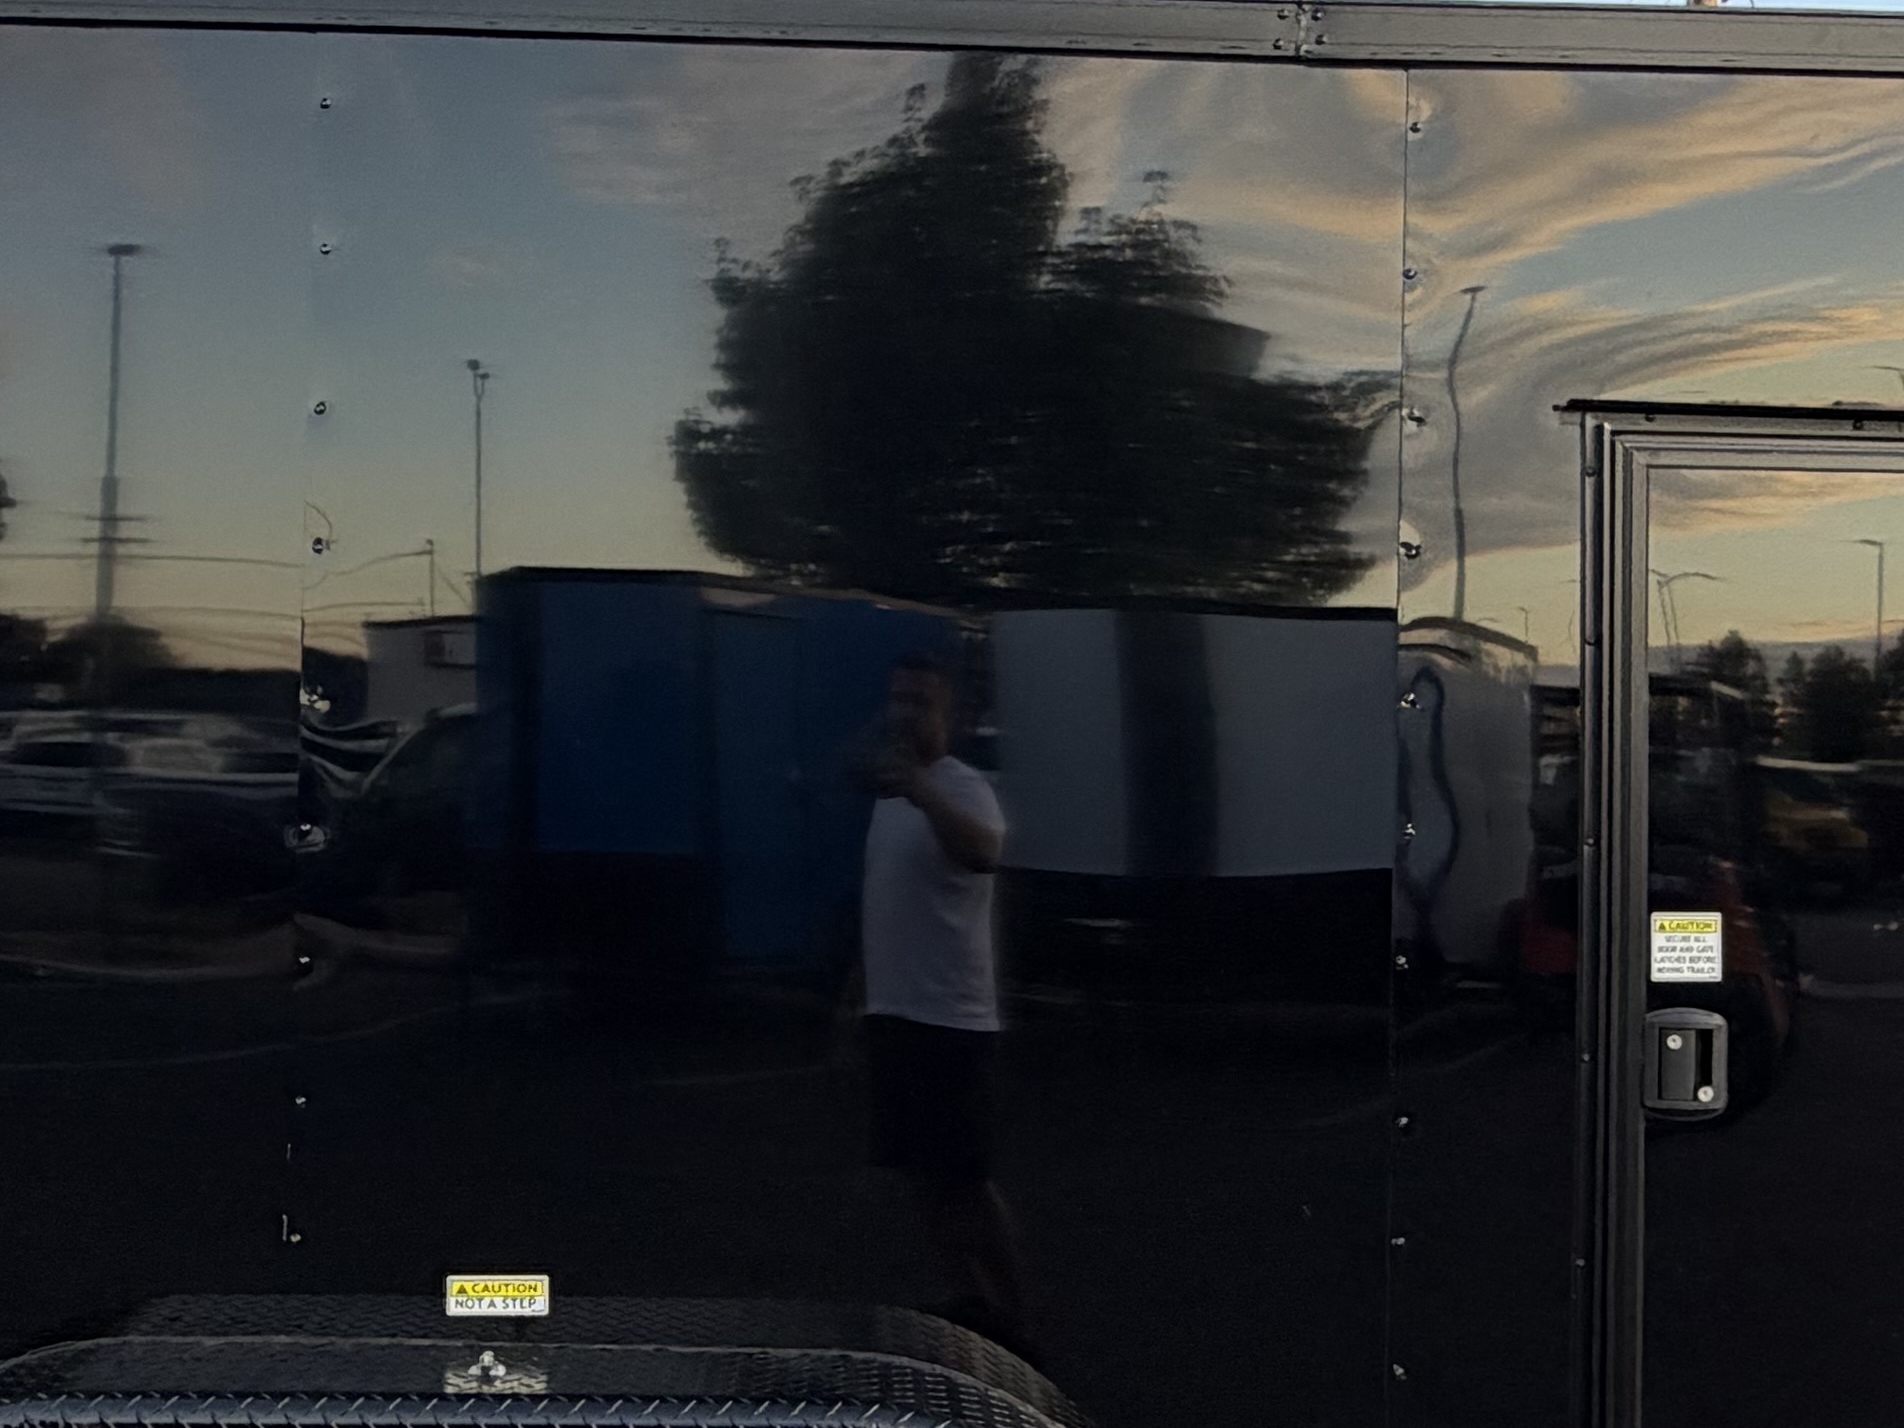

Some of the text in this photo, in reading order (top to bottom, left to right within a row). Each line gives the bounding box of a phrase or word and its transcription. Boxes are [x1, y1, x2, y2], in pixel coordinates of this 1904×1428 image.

[471, 1282, 538, 1294] CAUTION
[454, 1298, 537, 1310] NOT A STEP
